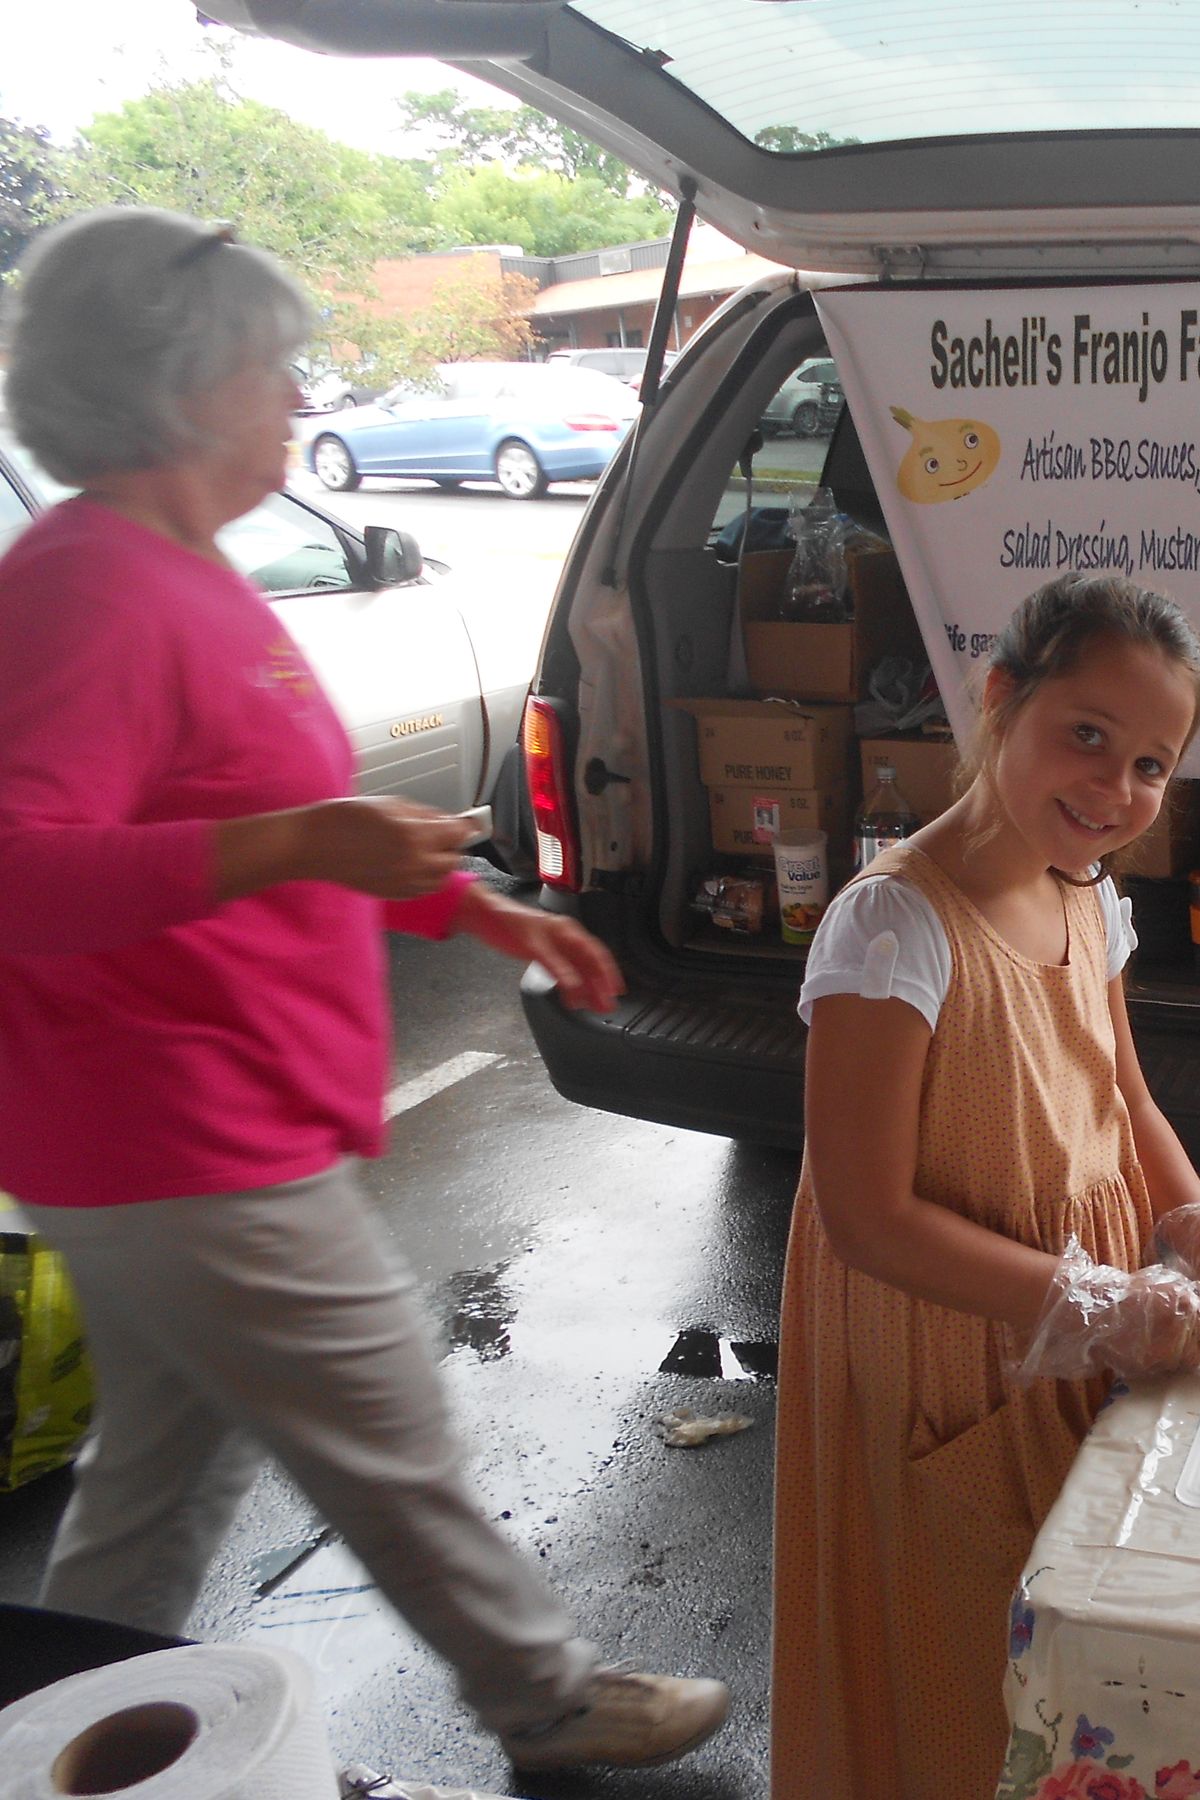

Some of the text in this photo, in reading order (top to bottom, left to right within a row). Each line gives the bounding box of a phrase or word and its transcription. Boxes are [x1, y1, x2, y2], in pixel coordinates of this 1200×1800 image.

[931, 316, 1062, 389] Sacheli's
[1073, 312, 1168, 403] Franjo
[1020, 430, 1087, 482] Artisan
[1089, 437, 1133, 482] BBQ
[1134, 438, 1200, 487] Sauces,
[1000, 519, 1051, 568] Salad
[944, 623, 967, 652] ife
[390, 712, 444, 738] OUTBACK
[724, 763, 792, 781] PURE HONEY
[734, 830, 753, 844] PUR
[787, 870, 821, 882] Value
